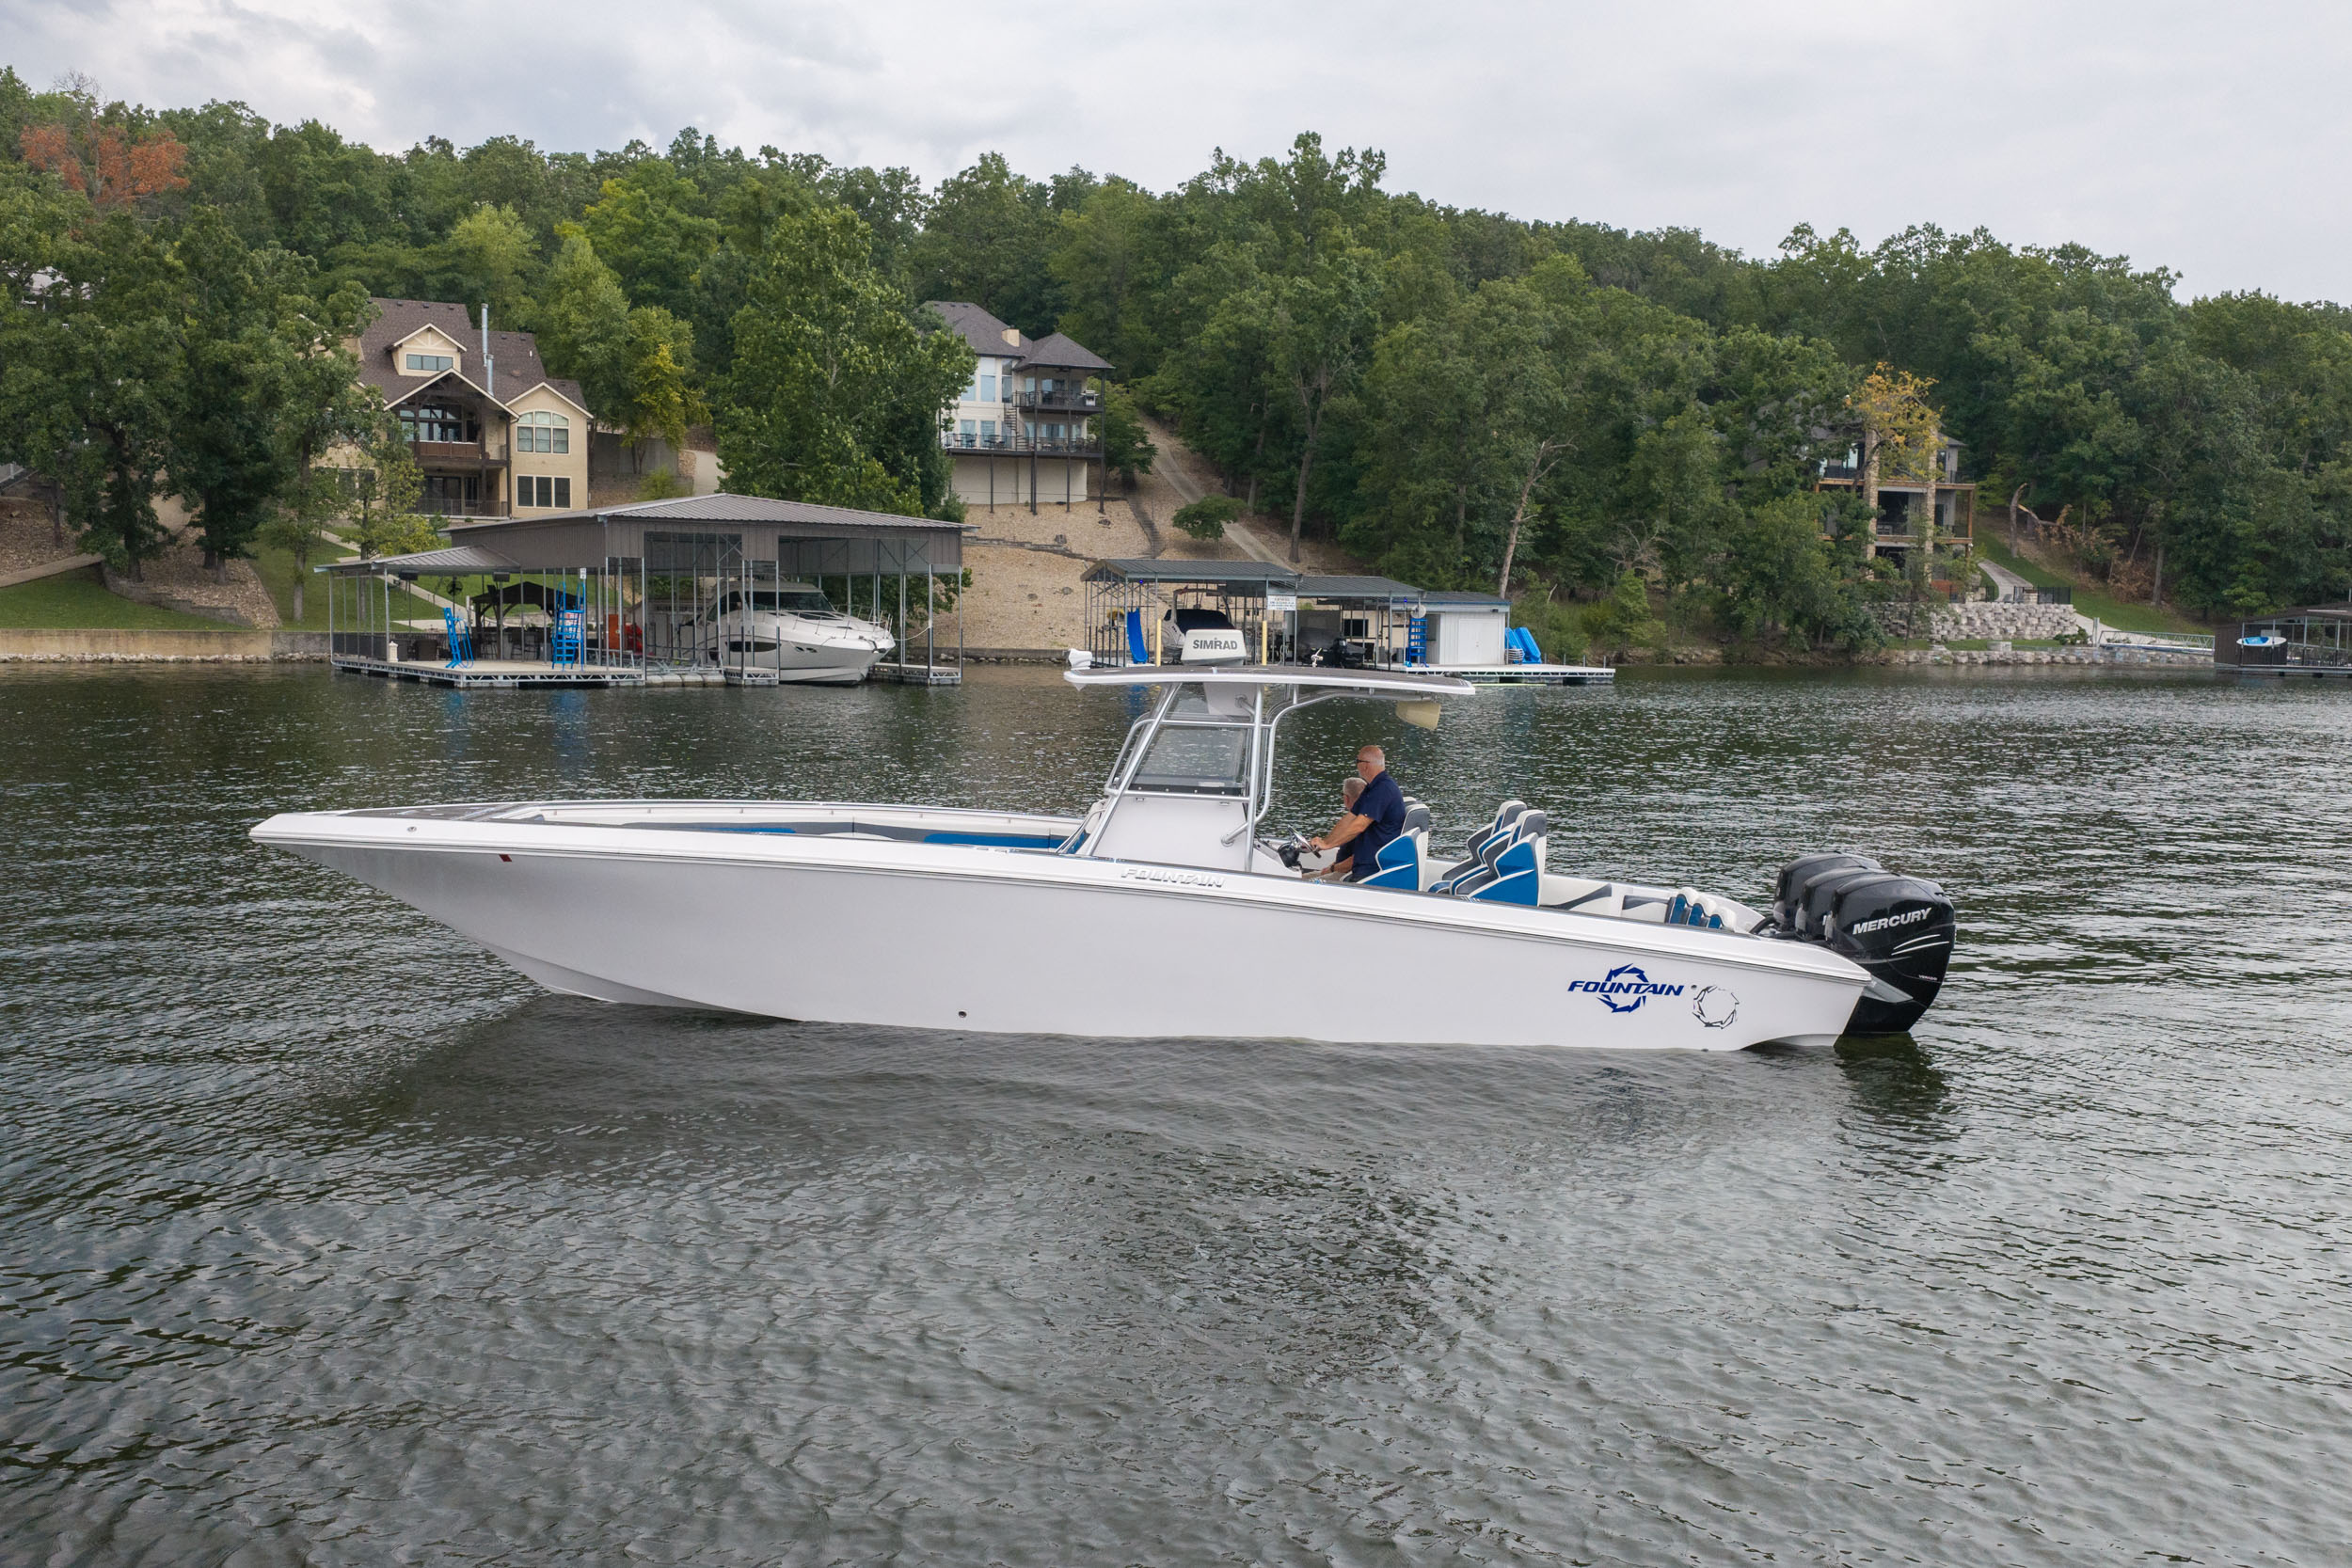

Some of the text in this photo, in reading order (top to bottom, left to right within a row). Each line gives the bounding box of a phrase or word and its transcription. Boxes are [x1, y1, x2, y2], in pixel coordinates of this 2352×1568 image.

[1192, 639, 1238, 650] SIMRAD
[1120, 867, 1225, 888] FOUNTAIN
[1852, 907, 1932, 935] MERCURY
[1567, 980, 1684, 996] FOUNTAIN
